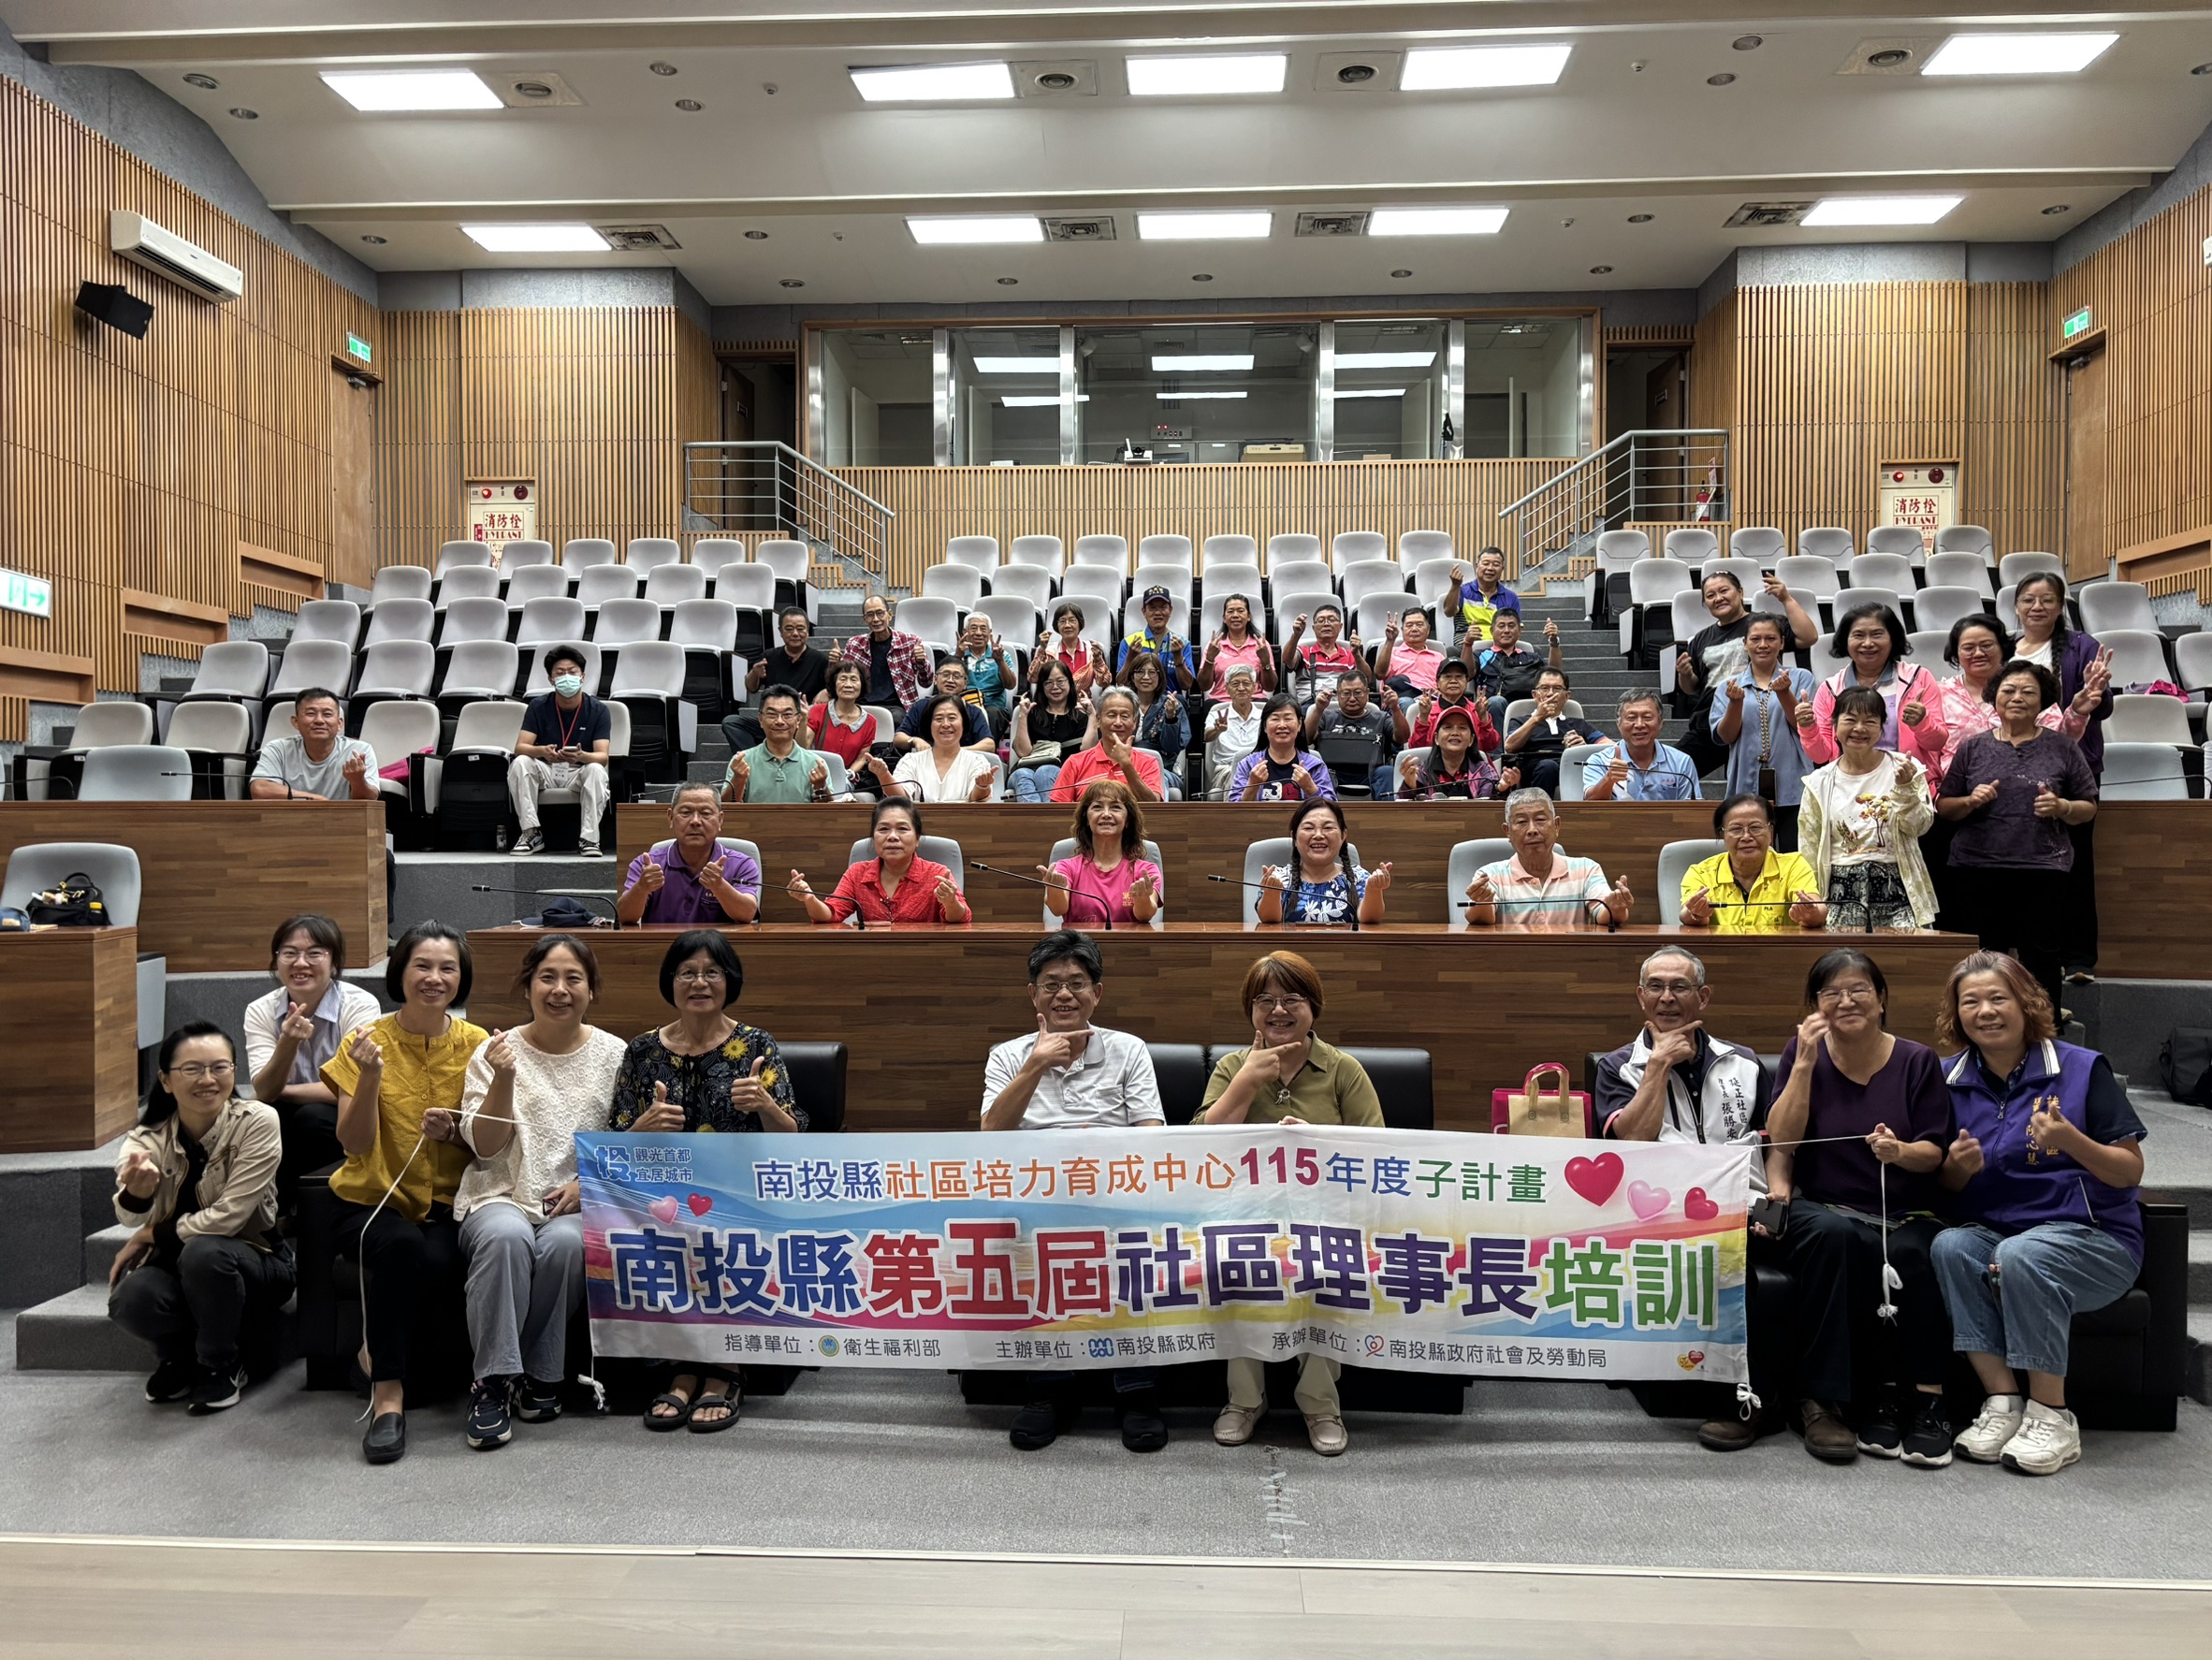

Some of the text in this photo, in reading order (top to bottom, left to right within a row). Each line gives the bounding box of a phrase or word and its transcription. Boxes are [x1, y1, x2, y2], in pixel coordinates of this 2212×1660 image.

[1895, 498, 1936, 514] 消防栓
[485, 513, 522, 529] 消防栓
[1895, 517, 1936, 525] HYDRANT
[1722, 1101, 1738, 1140] 張勝安
[634, 1147, 691, 1163] 觀光首都
[635, 1167, 693, 1183] 宜居城市
[754, 1146, 1548, 1203] 南投縣社區培力育成中心115年度子計畫
[609, 1220, 1720, 1328] 南投縣第五屆社區理事長培訓
[843, 1338, 941, 1358] 衛生福利部
[1115, 1332, 1215, 1356] 南投縣政府
[1390, 1339, 1608, 1368] 南投縣政府社會及勞動局
